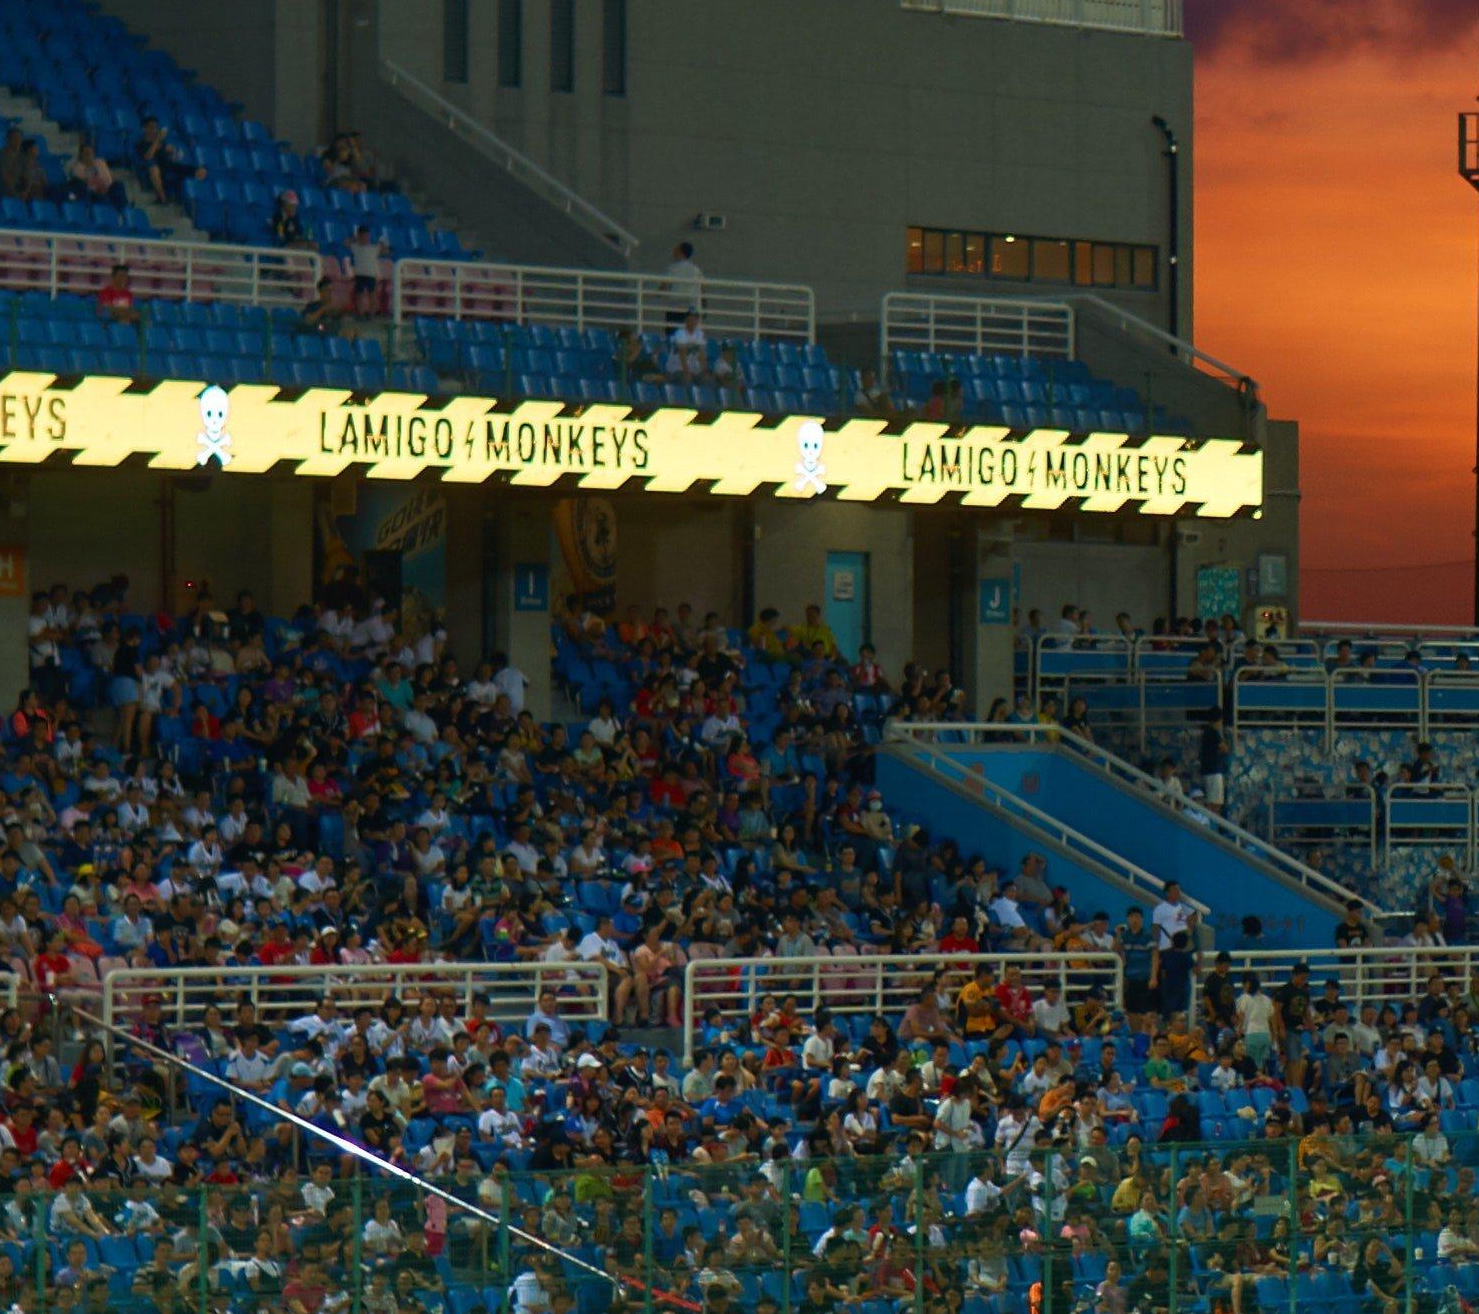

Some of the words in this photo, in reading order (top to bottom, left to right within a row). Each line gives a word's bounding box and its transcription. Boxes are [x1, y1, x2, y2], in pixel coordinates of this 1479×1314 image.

[320, 411, 454, 458] LAMIGO
[485, 419, 649, 469] MONKEYS
[902, 442, 1017, 486] LAMIGO
[1045, 449, 1187, 495] MONKEYS
[988, 585, 1002, 610] J
